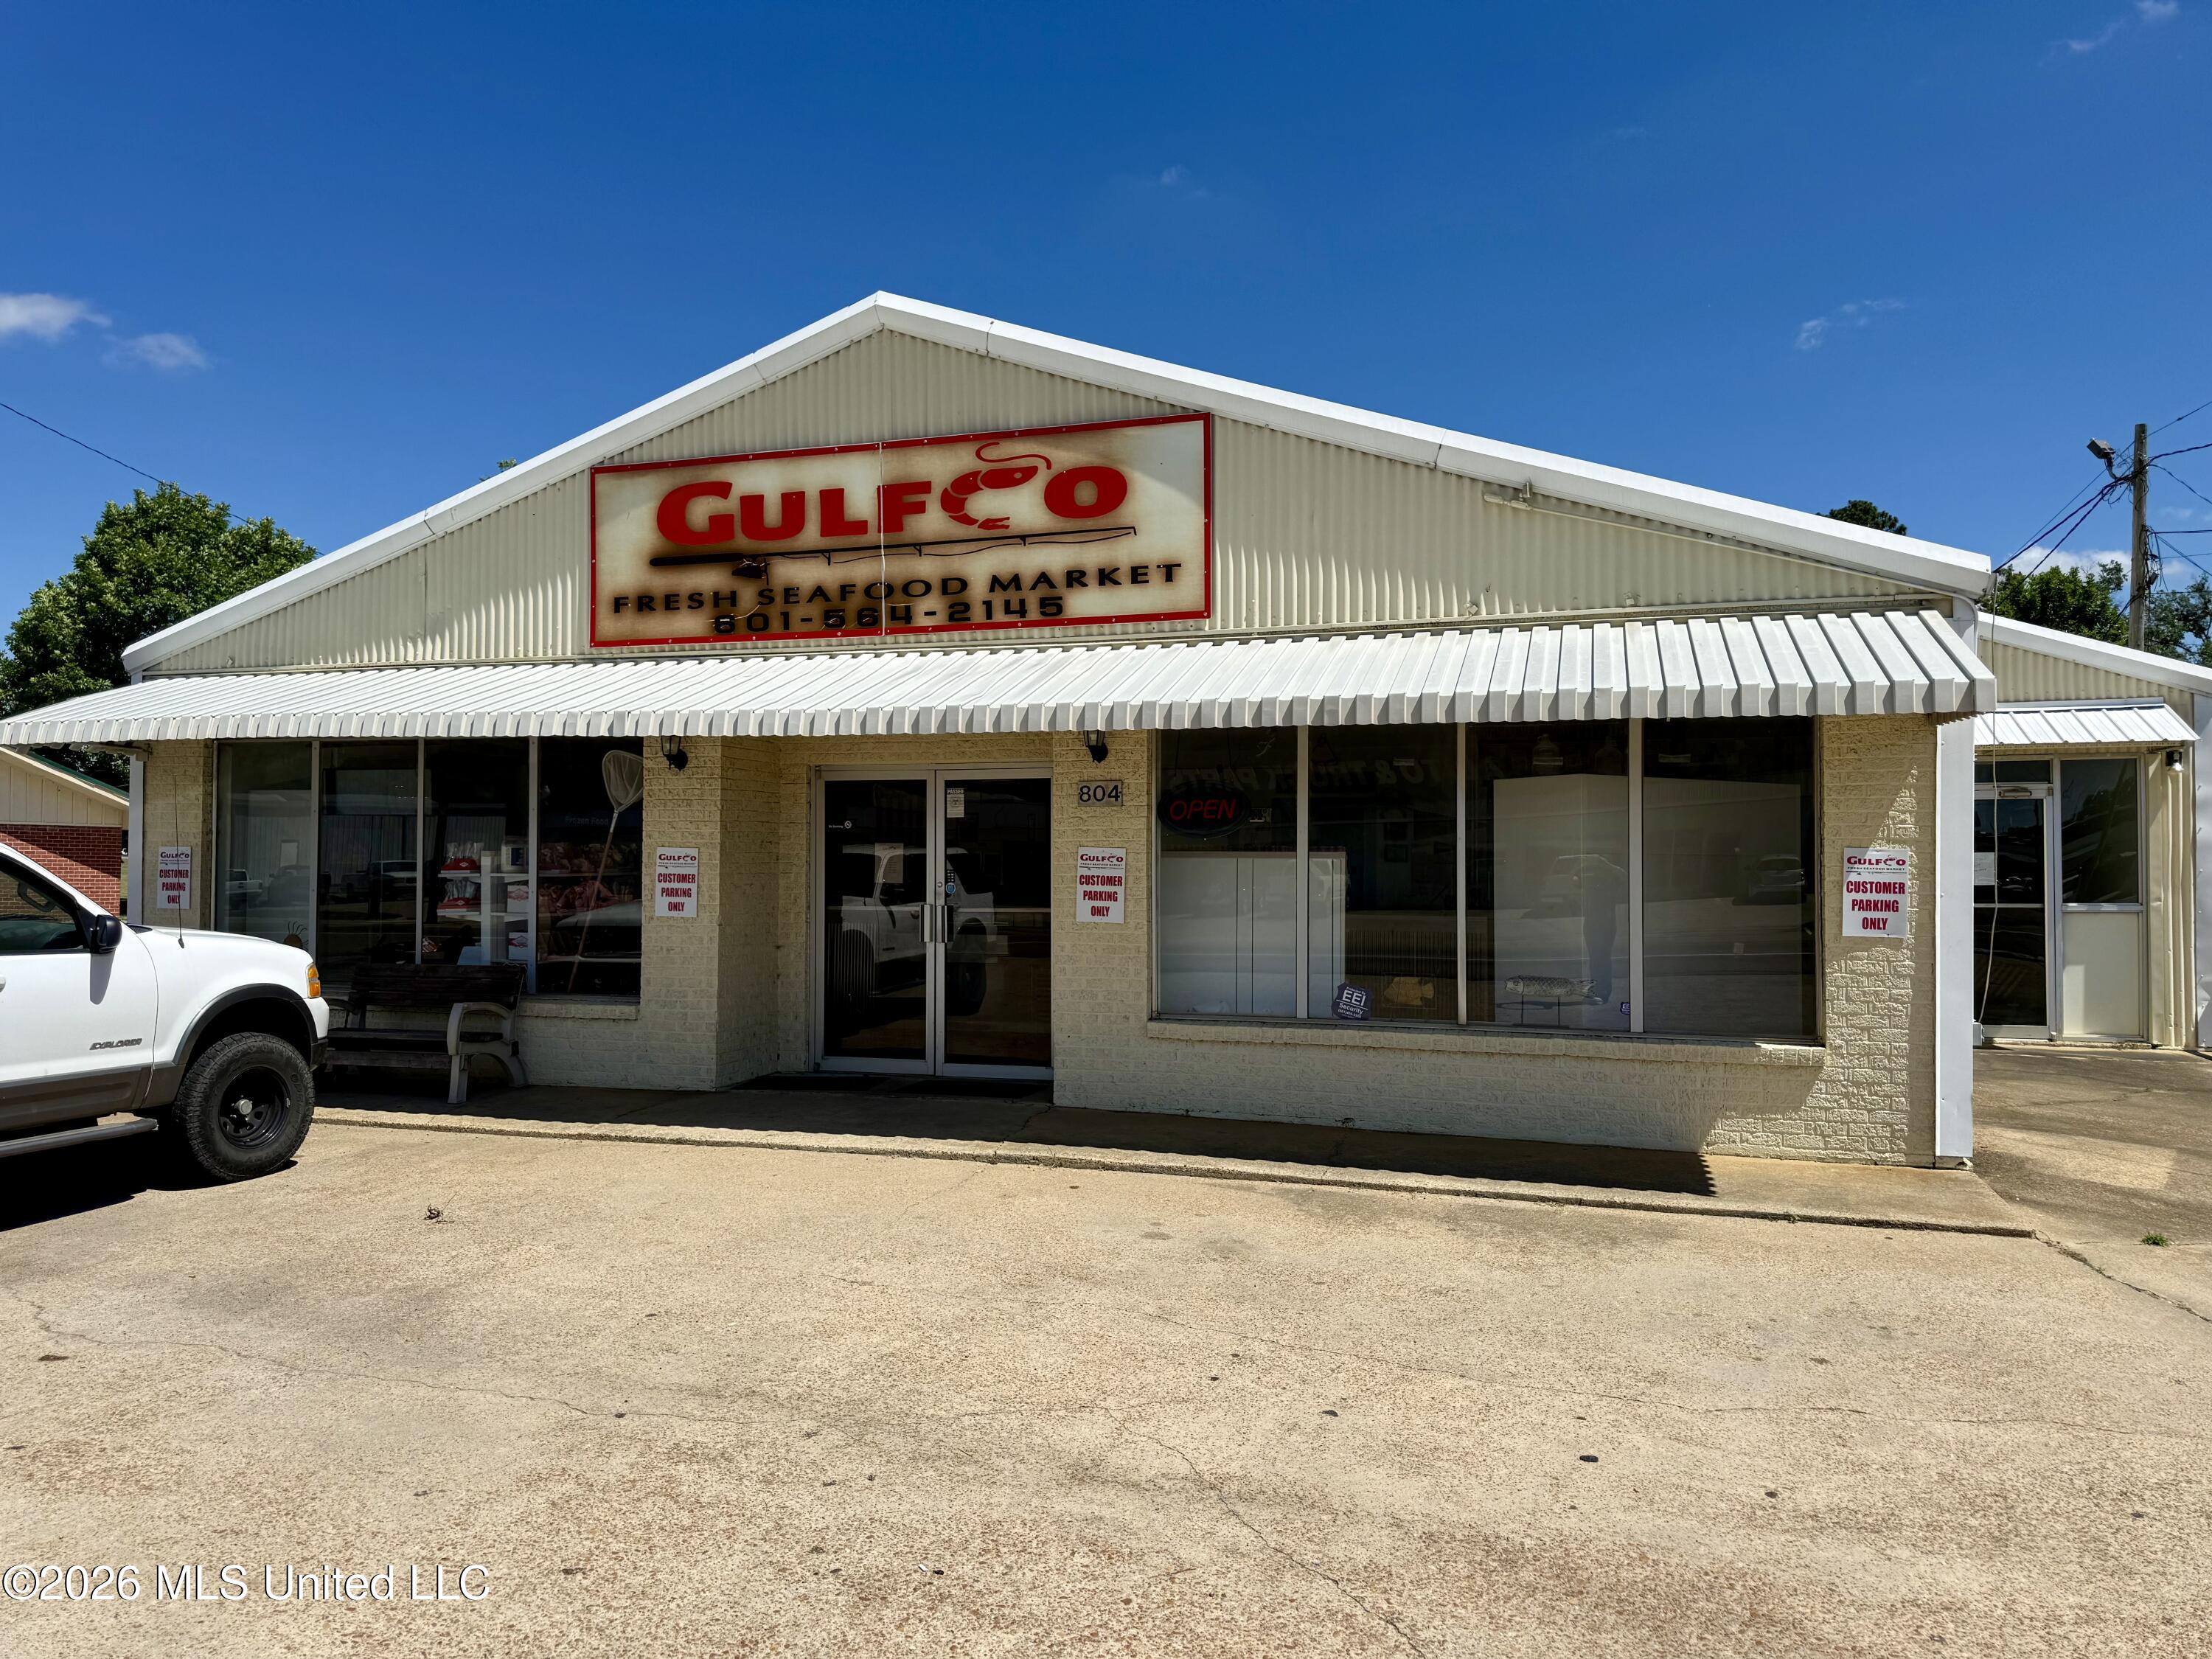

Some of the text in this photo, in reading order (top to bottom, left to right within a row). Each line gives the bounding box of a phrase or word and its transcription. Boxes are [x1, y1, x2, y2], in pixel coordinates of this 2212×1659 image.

[613, 563, 1182, 614] FRESH SEAFOOD MARKET
[712, 596, 1063, 635] 601-564-2145
[1079, 785, 1120, 802] 804
[1169, 799, 1237, 821] OPEN
[159, 869, 189, 879] CUSTOMER
[658, 873, 696, 883] CUSTOMER
[1079, 874, 1122, 887] CUSTOMER
[161, 882, 186, 891] PARKING
[661, 887, 692, 898] PARKING
[1846, 880, 1905, 894] CUSTOMER
[167, 894, 181, 904] ONLY
[1082, 890, 1118, 902] PARKING
[668, 901, 685, 912] ONLY
[1091, 905, 1110, 917] ONLY
[1851, 899, 1899, 913] PARKING
[1862, 917, 1888, 930] ONLY
[1342, 990, 1366, 1006] EEI
[1339, 1003, 1363, 1015] Security
[89, 1037, 142, 1051] EXPLORER
